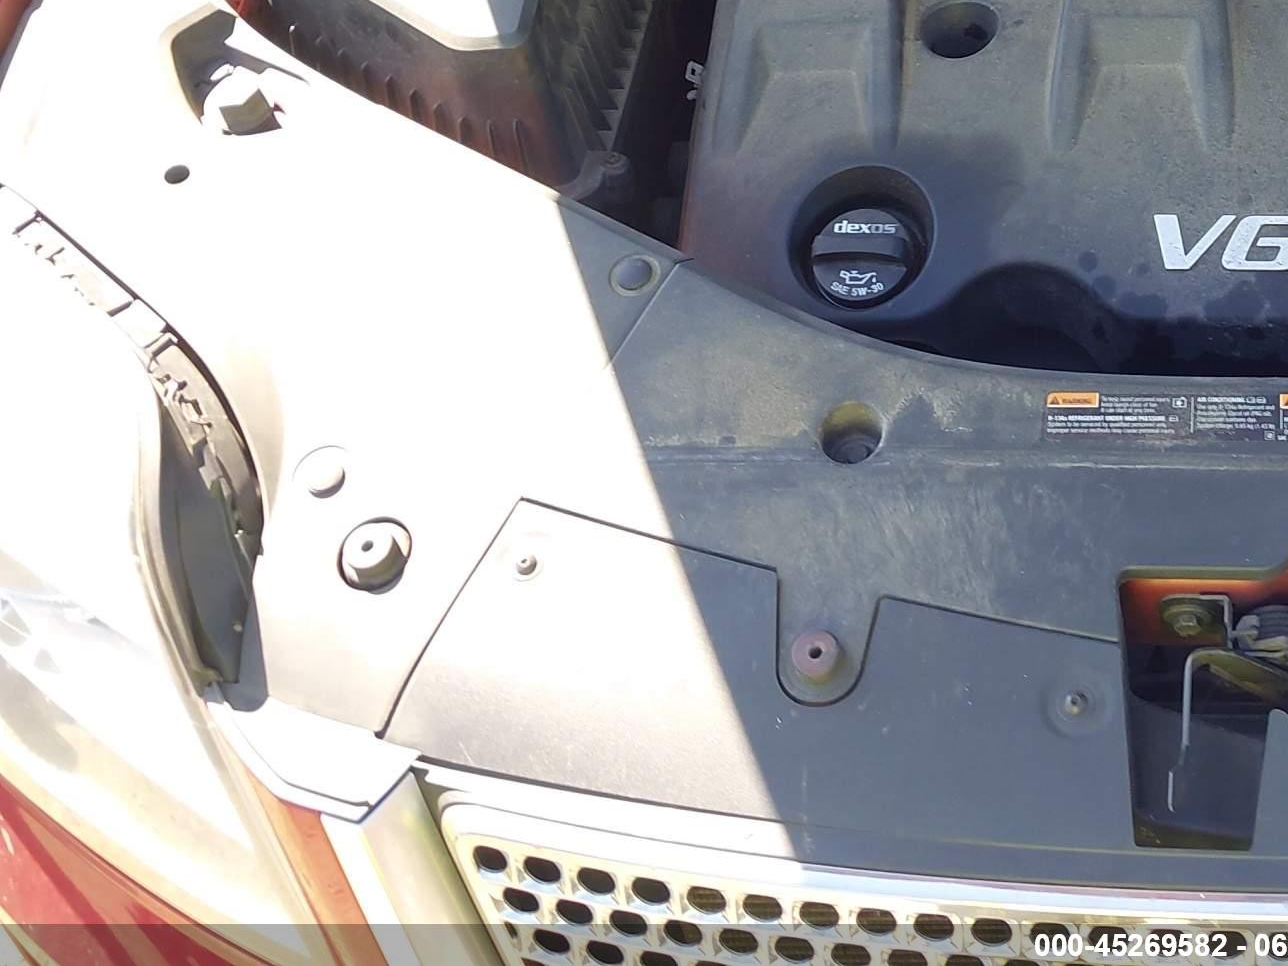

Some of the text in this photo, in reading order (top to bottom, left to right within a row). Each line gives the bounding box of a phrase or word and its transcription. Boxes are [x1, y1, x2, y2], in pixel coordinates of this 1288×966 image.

[833, 219, 899, 234] dexos
[830, 281, 884, 297] SAE 5W-30
